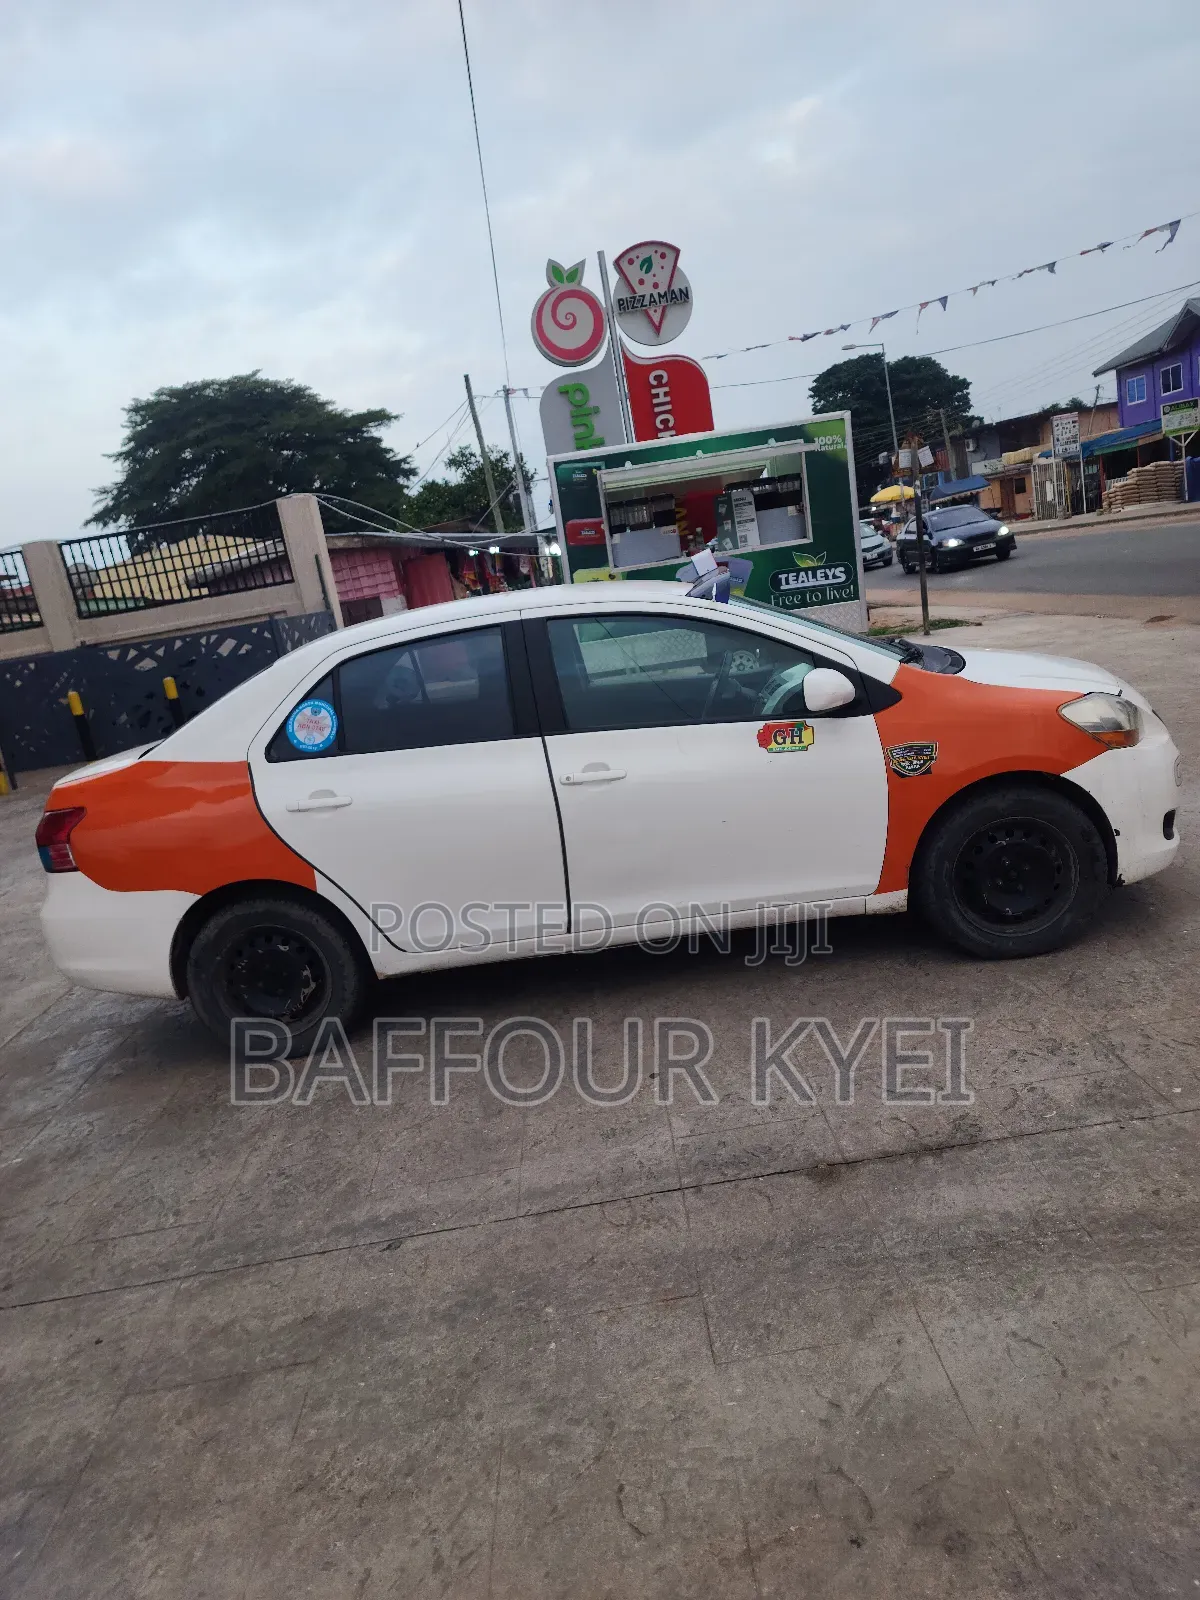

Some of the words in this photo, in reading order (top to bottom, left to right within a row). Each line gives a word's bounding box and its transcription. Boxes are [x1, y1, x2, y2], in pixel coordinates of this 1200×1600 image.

[617, 286, 690, 312] PIZZAMAN
[814, 434, 842, 445] 100%
[778, 566, 847, 590] TEALEYS
[771, 594, 802, 606] Free
[806, 591, 822, 602] to
[826, 584, 854, 600] live!
[772, 727, 805, 746] GH
